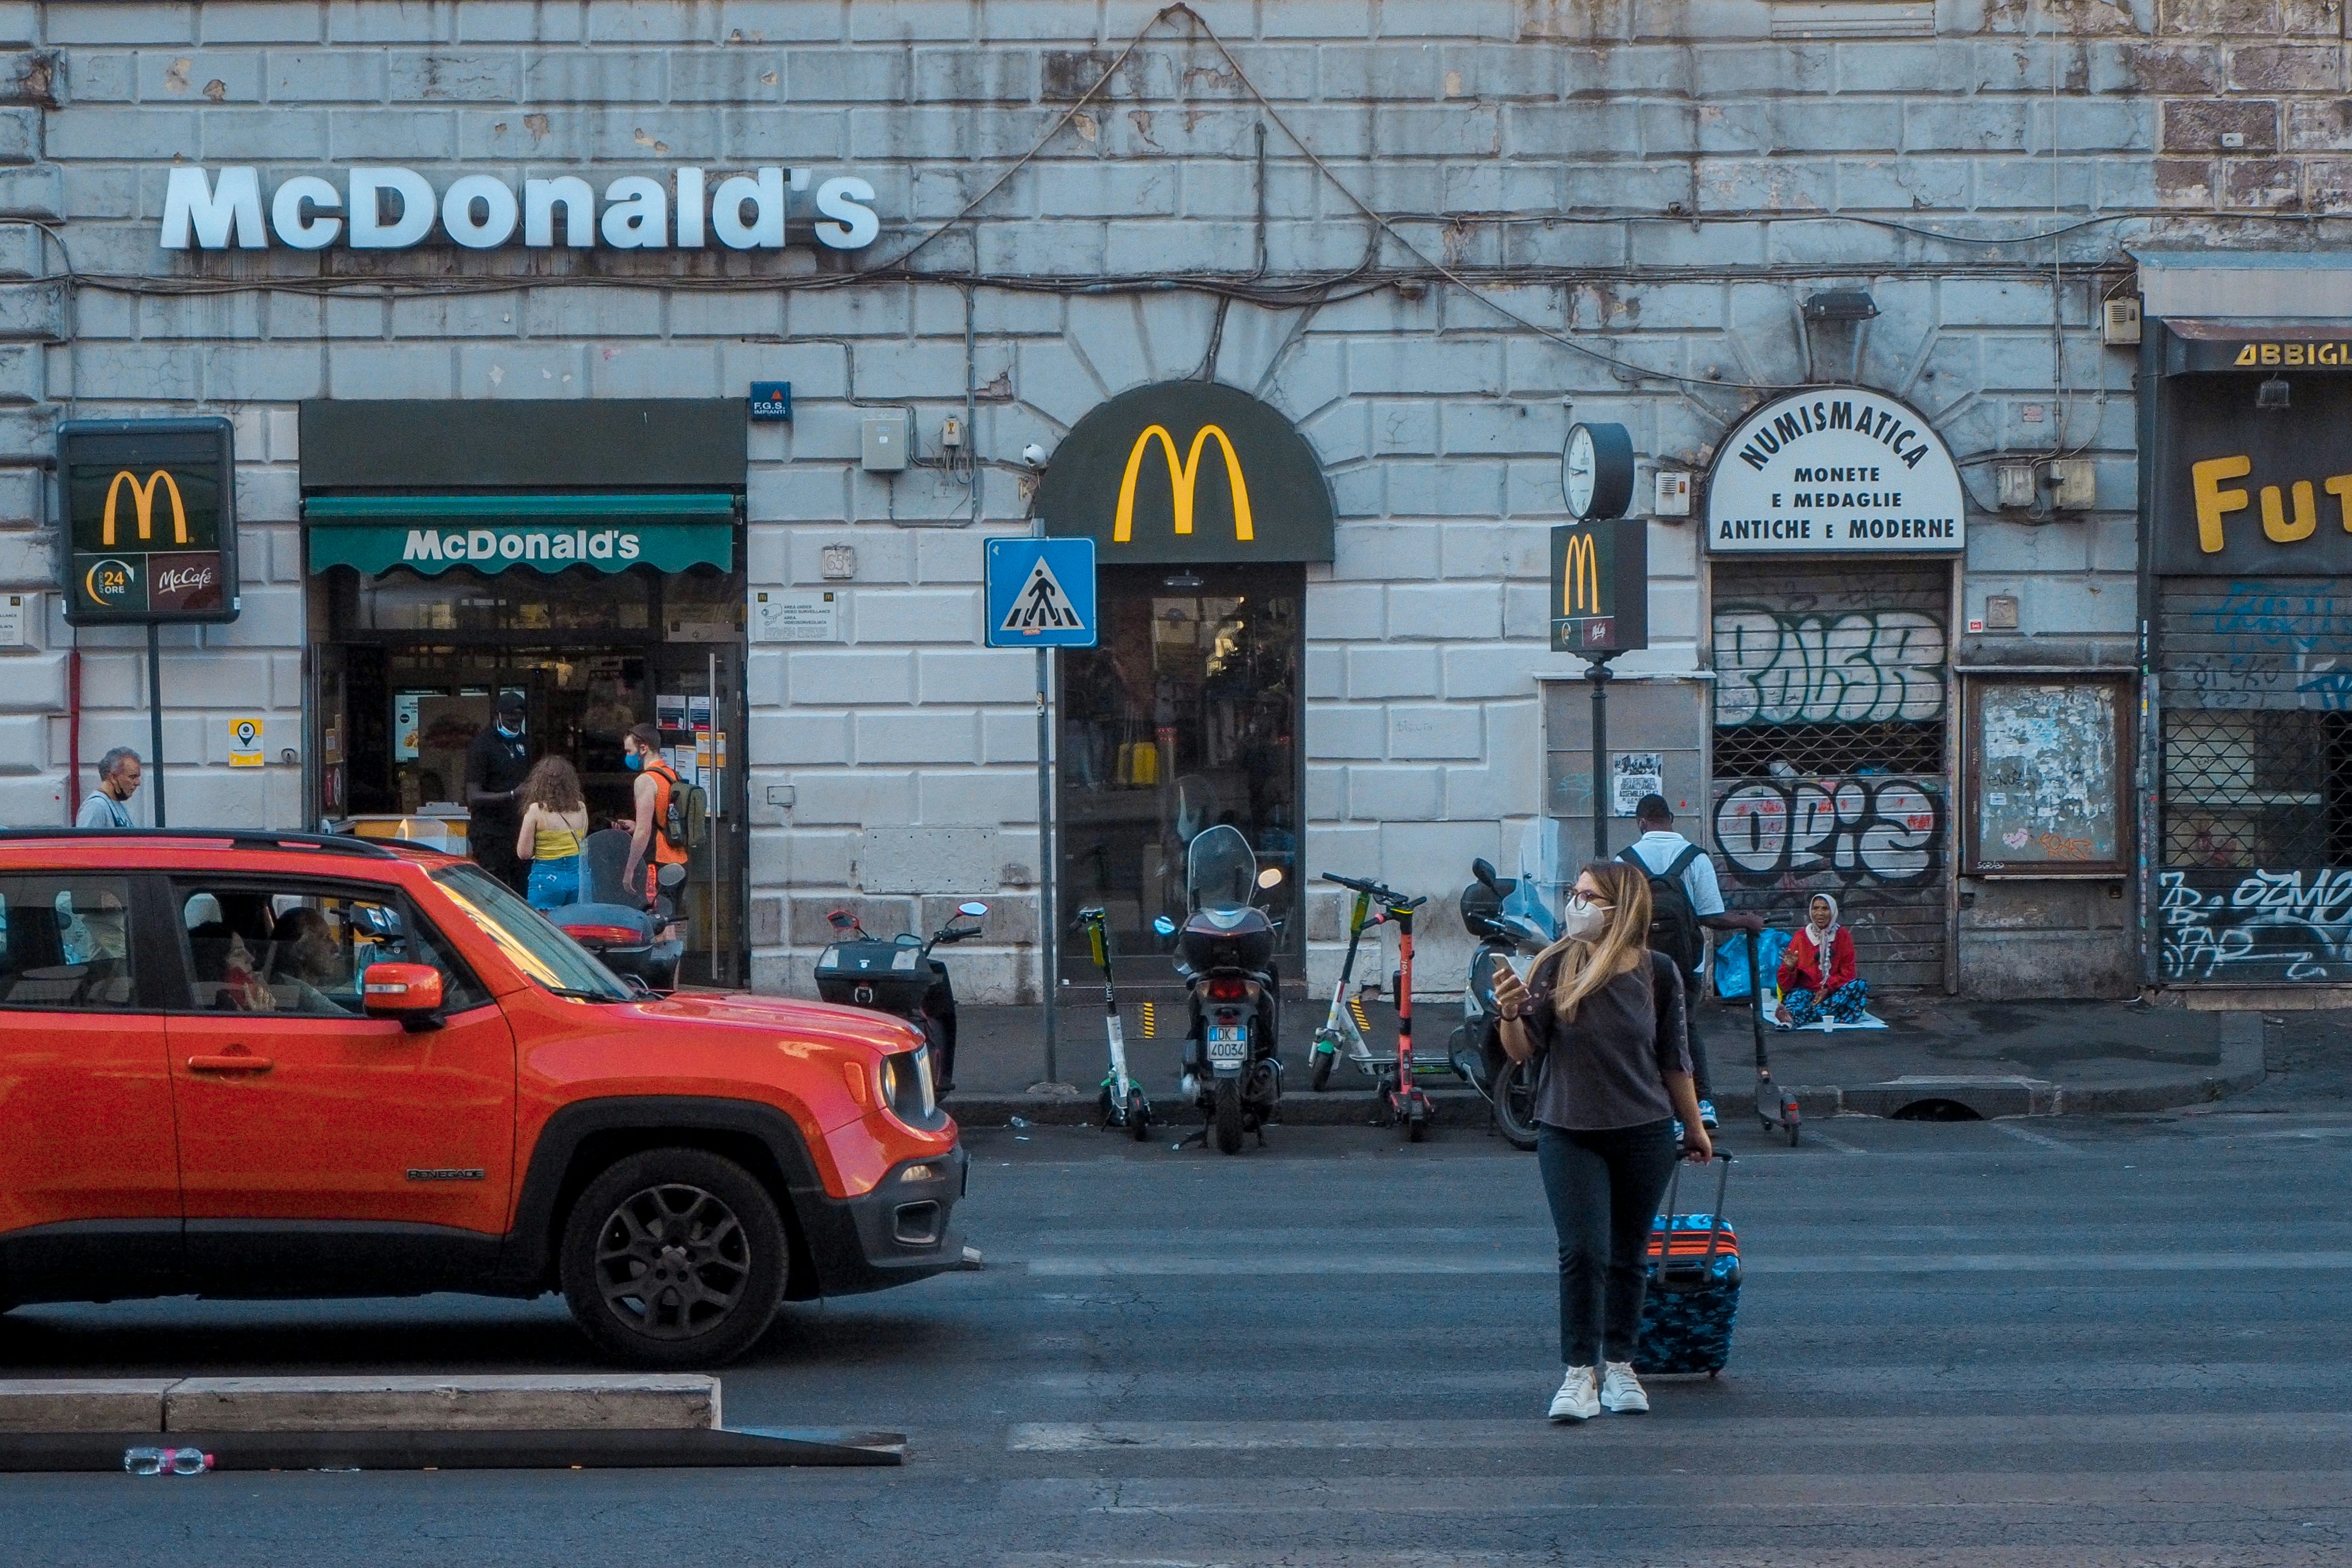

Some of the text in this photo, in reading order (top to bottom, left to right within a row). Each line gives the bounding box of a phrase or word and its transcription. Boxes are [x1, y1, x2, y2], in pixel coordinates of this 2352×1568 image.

[160, 166, 879, 250] McDonald's
[754, 402, 786, 410] F.G.S.
[1739, 402, 1929, 472] NUMISMATICA
[1794, 467, 1879, 482] MONETE
[1772, 493, 1902, 507] E MEDAGLIE
[1720, 519, 1954, 539] ANTICHE E MODERNE
[402, 530, 640, 560] McDonald's
[104, 571, 124, 586] 24
[158, 567, 212, 593] McCafé
[104, 586, 125, 594] ORE
[1219, 1028, 1231, 1041] DK
[1211, 1044, 1243, 1056] 40034
[407, 1169, 484, 1180] RENEGADE
